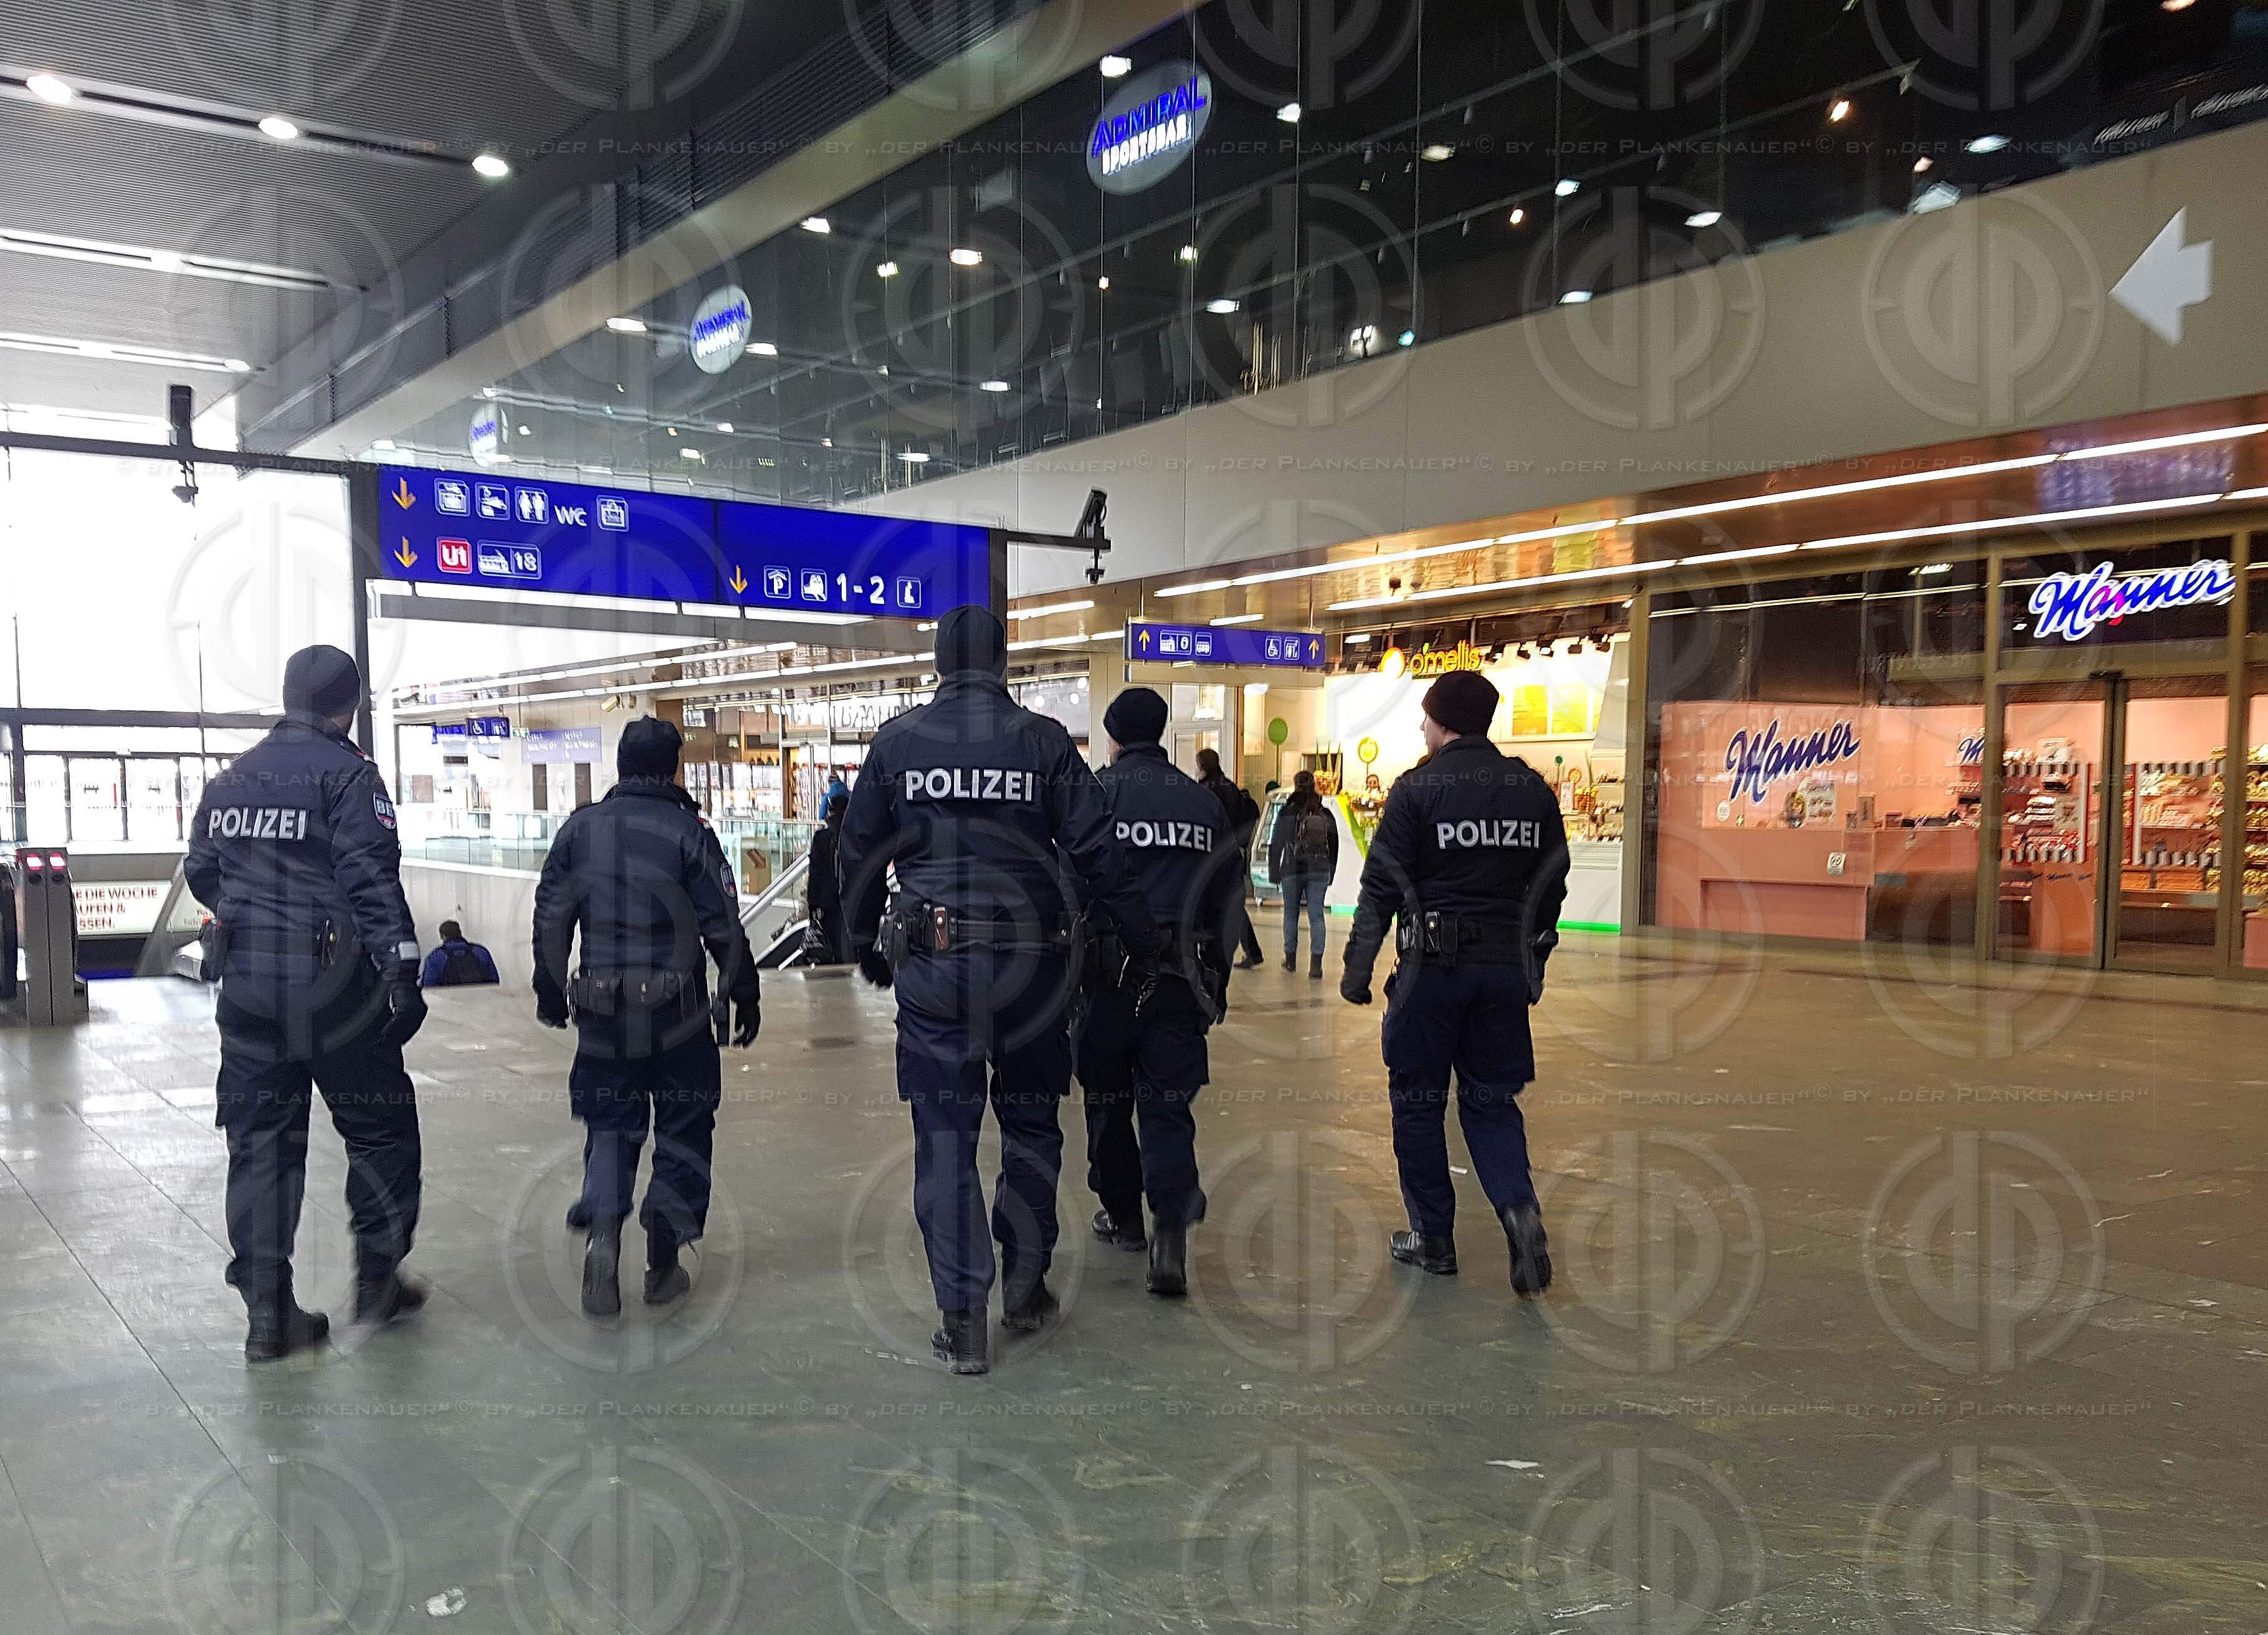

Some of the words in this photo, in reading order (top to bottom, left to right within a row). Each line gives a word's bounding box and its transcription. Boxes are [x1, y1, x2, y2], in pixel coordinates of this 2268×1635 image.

[1092, 75, 1206, 158] ADMIRAL
[554, 504, 588, 527] WC
[441, 543, 467, 567] U1
[513, 550, 538, 571] 18
[2029, 558, 2236, 641] Manner
[1725, 717, 1861, 806] Manner
[905, 768, 1033, 802] POLIZEI
[207, 808, 307, 841] POLIZEI
[1115, 821, 1213, 853] POLIZEI
[1436, 819, 1540, 849] POLIZEI
[85, 888, 105, 900] DIE
[108, 887, 158, 900] WOCHE
